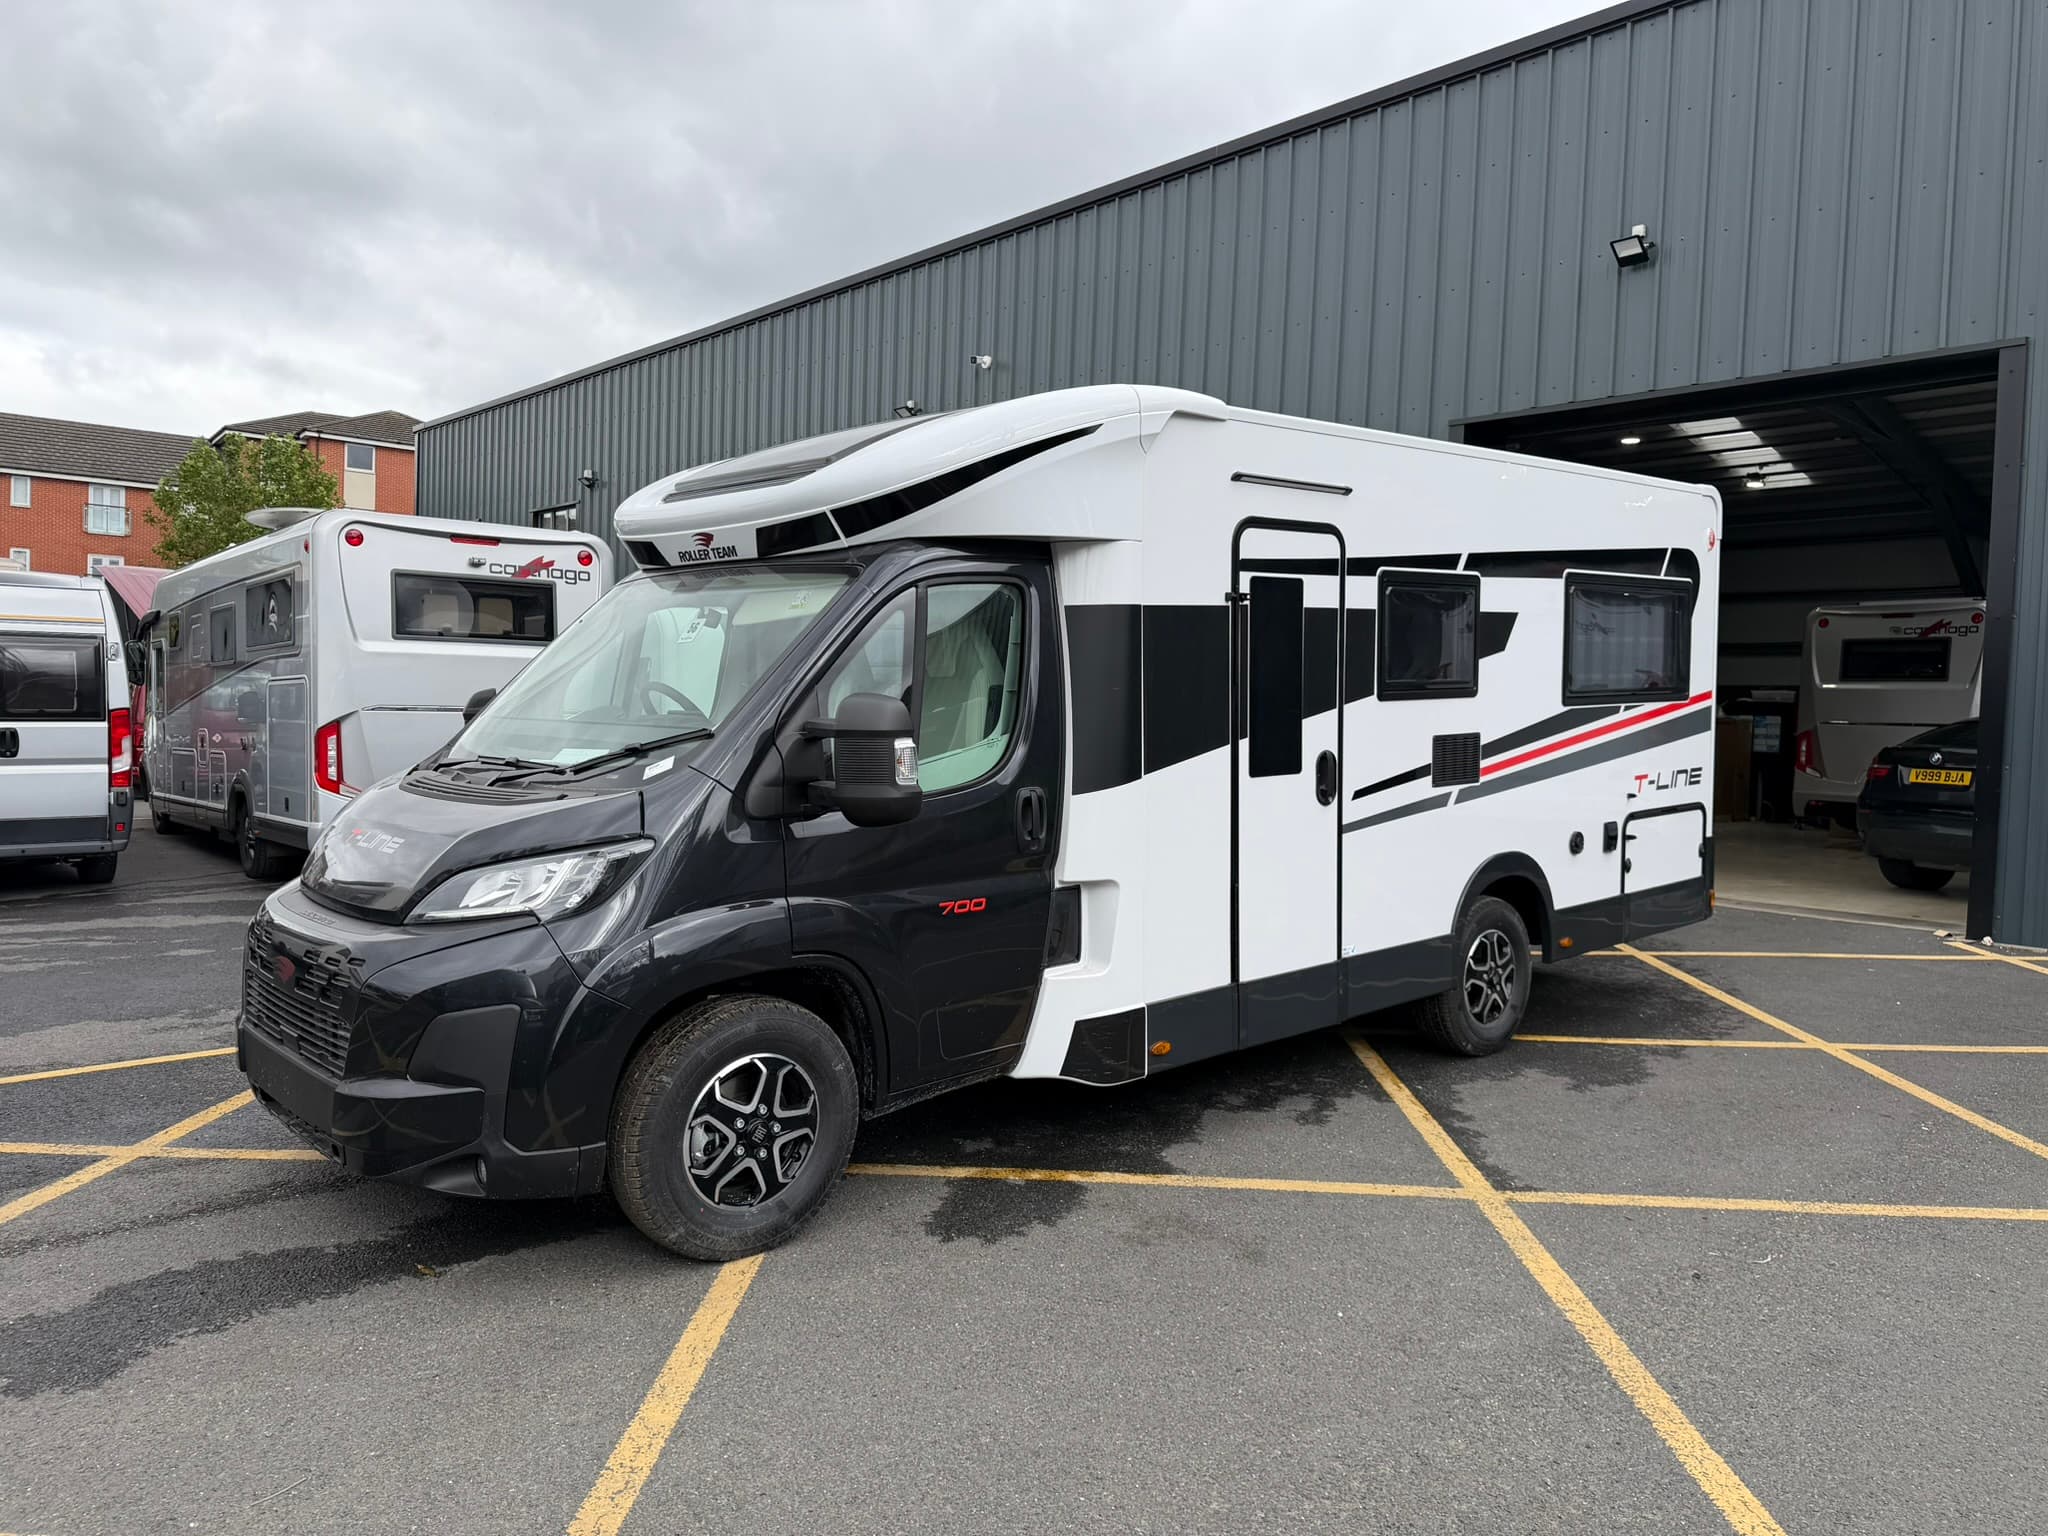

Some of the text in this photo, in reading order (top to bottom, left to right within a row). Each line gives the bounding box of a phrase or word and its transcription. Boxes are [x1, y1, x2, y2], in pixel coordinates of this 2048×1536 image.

[678, 545, 738, 563] ROLLER TEAM
[489, 560, 591, 585] cahago
[1903, 623, 1980, 637] cahago
[1634, 766, 1703, 793] T-LINE
[1915, 770, 1942, 782] V999
[938, 898, 987, 915] 700
[751, 1125, 767, 1143] FIAT
